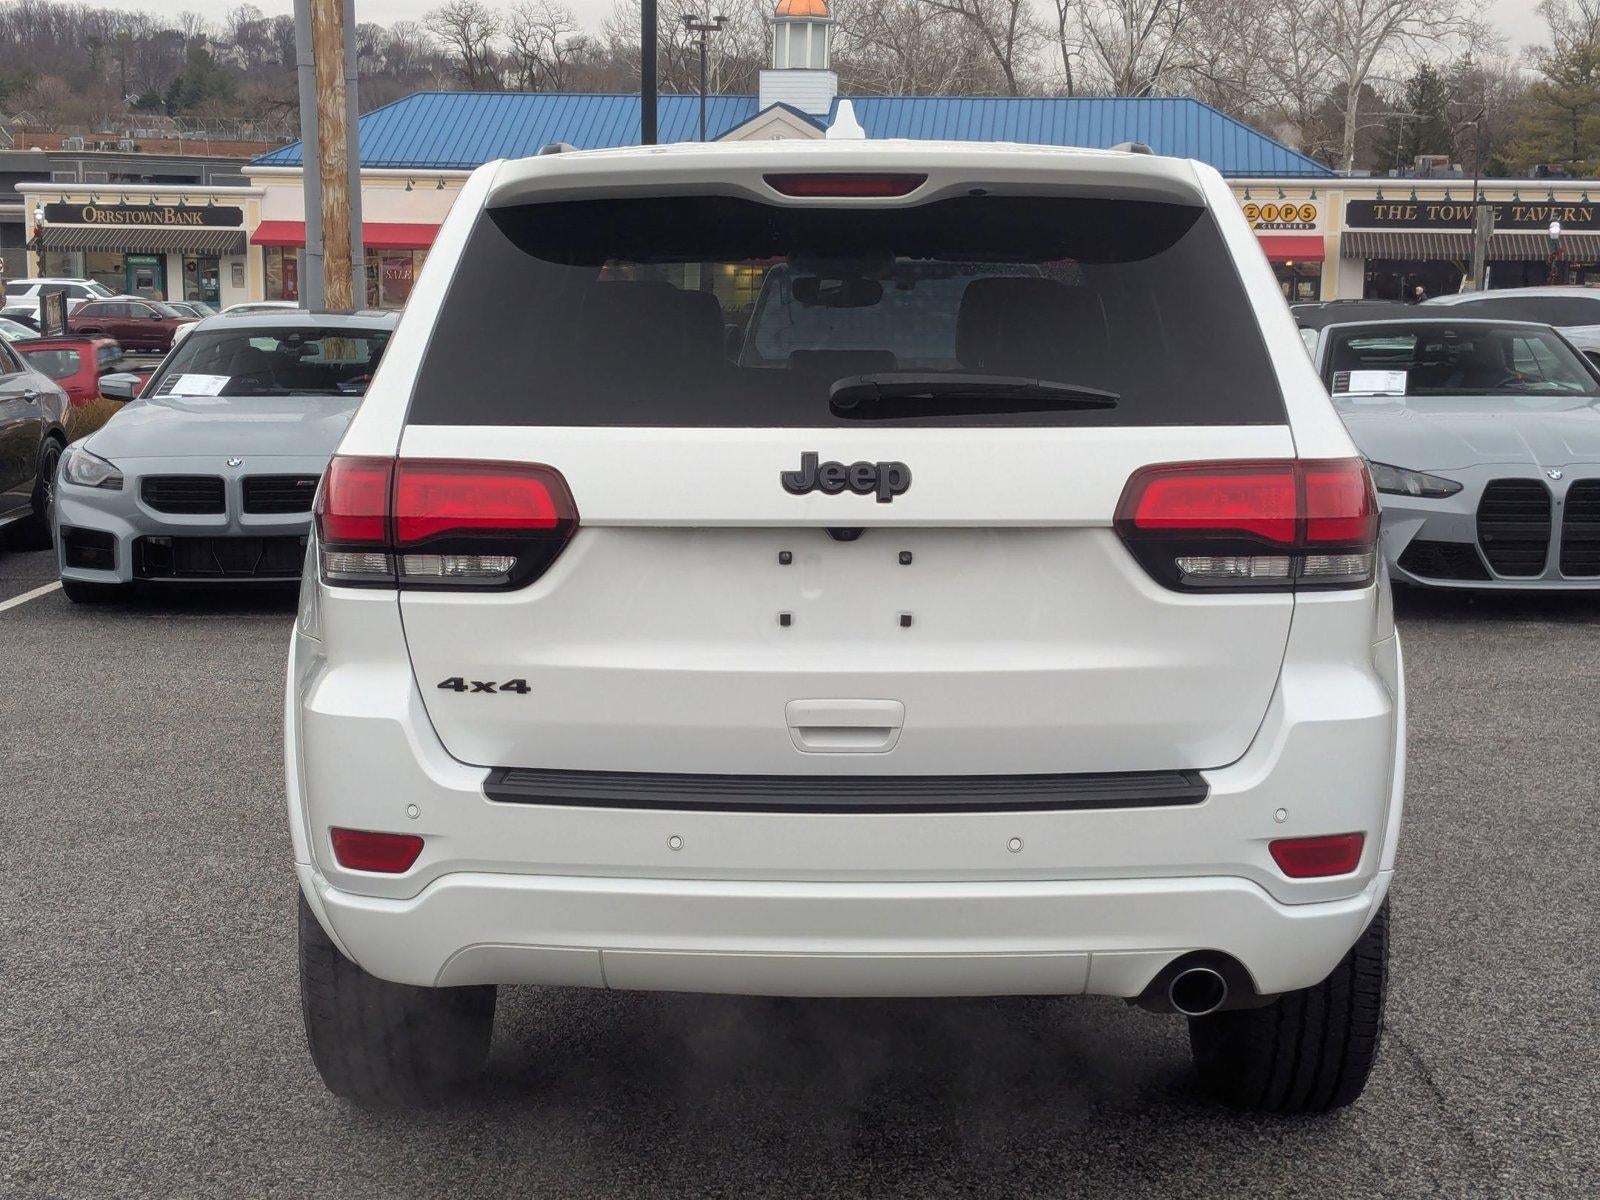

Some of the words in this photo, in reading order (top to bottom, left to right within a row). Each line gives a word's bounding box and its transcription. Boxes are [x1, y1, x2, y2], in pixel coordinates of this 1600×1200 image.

[1246, 207, 1312, 219] ZIPS
[1373, 205, 1417, 220] THE
[1427, 206, 1502, 221] TOWE
[1512, 206, 1593, 222] TAVERN
[780, 451, 912, 503] Jeep
[437, 677, 531, 694] 4x4
